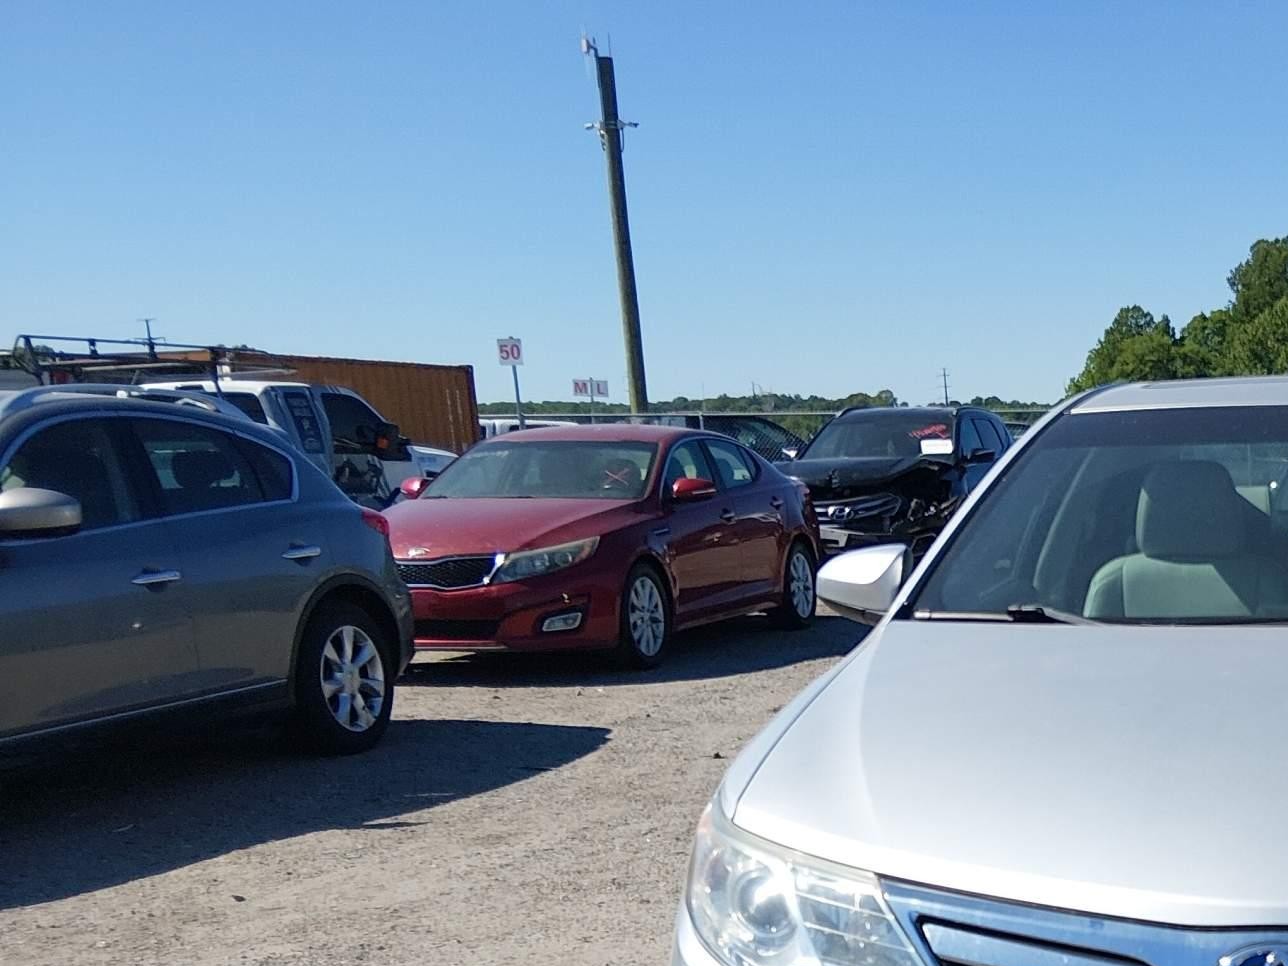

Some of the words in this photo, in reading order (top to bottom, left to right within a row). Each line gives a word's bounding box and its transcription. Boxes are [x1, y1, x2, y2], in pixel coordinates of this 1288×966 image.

[499, 343, 521, 361] 50
[574, 382, 588, 394] M
[596, 383, 605, 395] L
